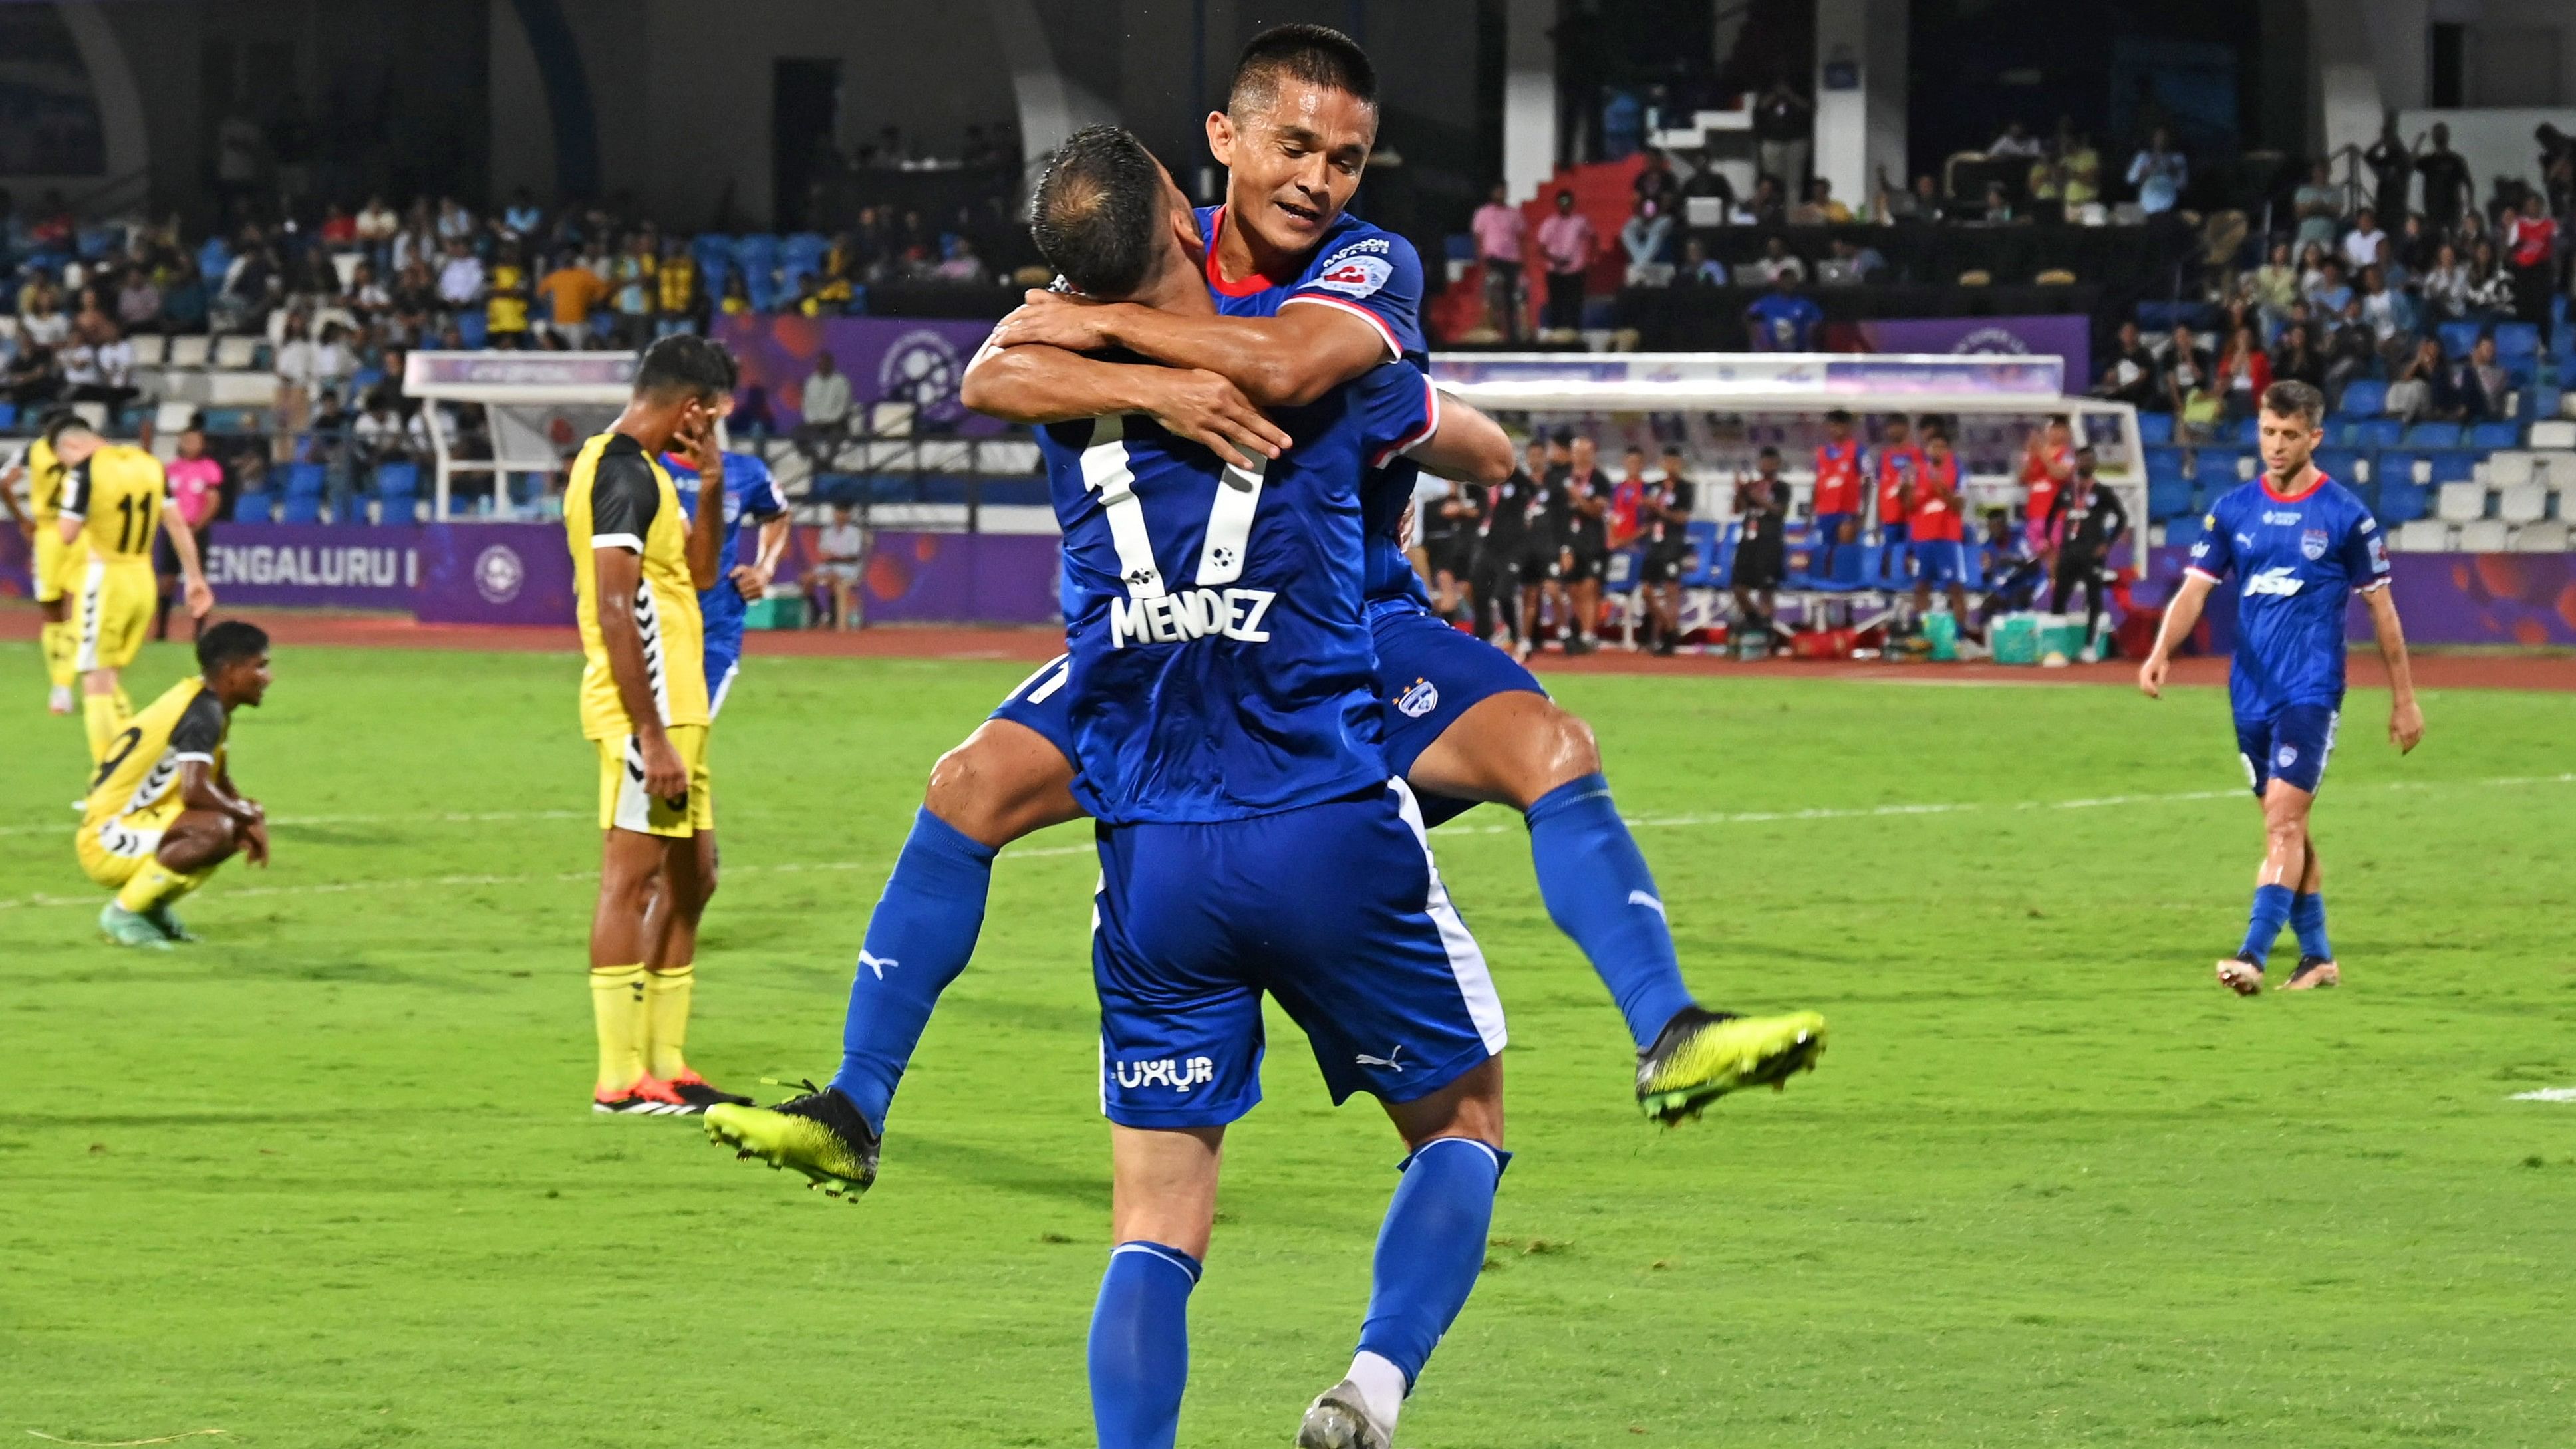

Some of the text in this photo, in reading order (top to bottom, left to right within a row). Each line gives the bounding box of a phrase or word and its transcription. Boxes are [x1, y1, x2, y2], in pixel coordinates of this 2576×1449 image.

[117, 491, 152, 555] 11
[178, 545, 397, 586] ENGALURU
[1110, 588, 1277, 648] MENDEZ
